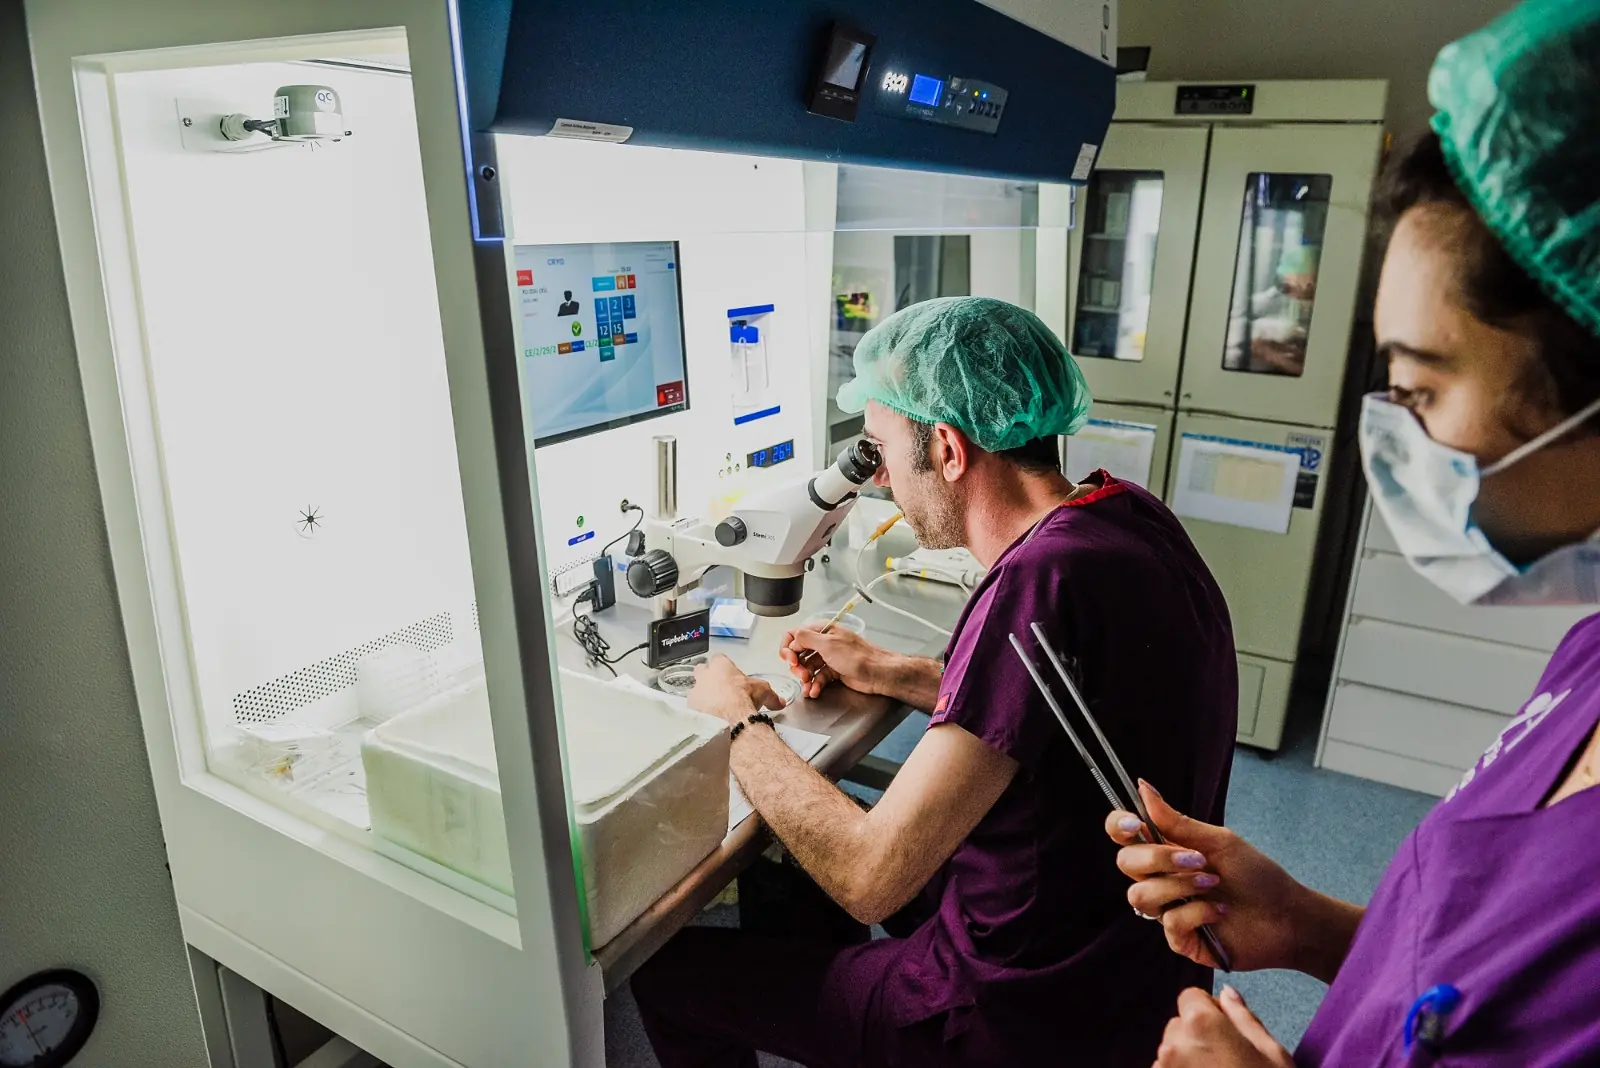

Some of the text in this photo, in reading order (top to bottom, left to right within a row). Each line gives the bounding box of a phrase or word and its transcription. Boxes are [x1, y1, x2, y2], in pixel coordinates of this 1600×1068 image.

[317, 92, 332, 102] QC
[547, 258, 565, 266] CRYO
[599, 325, 608, 336] 12
[613, 323, 622, 334] 15
